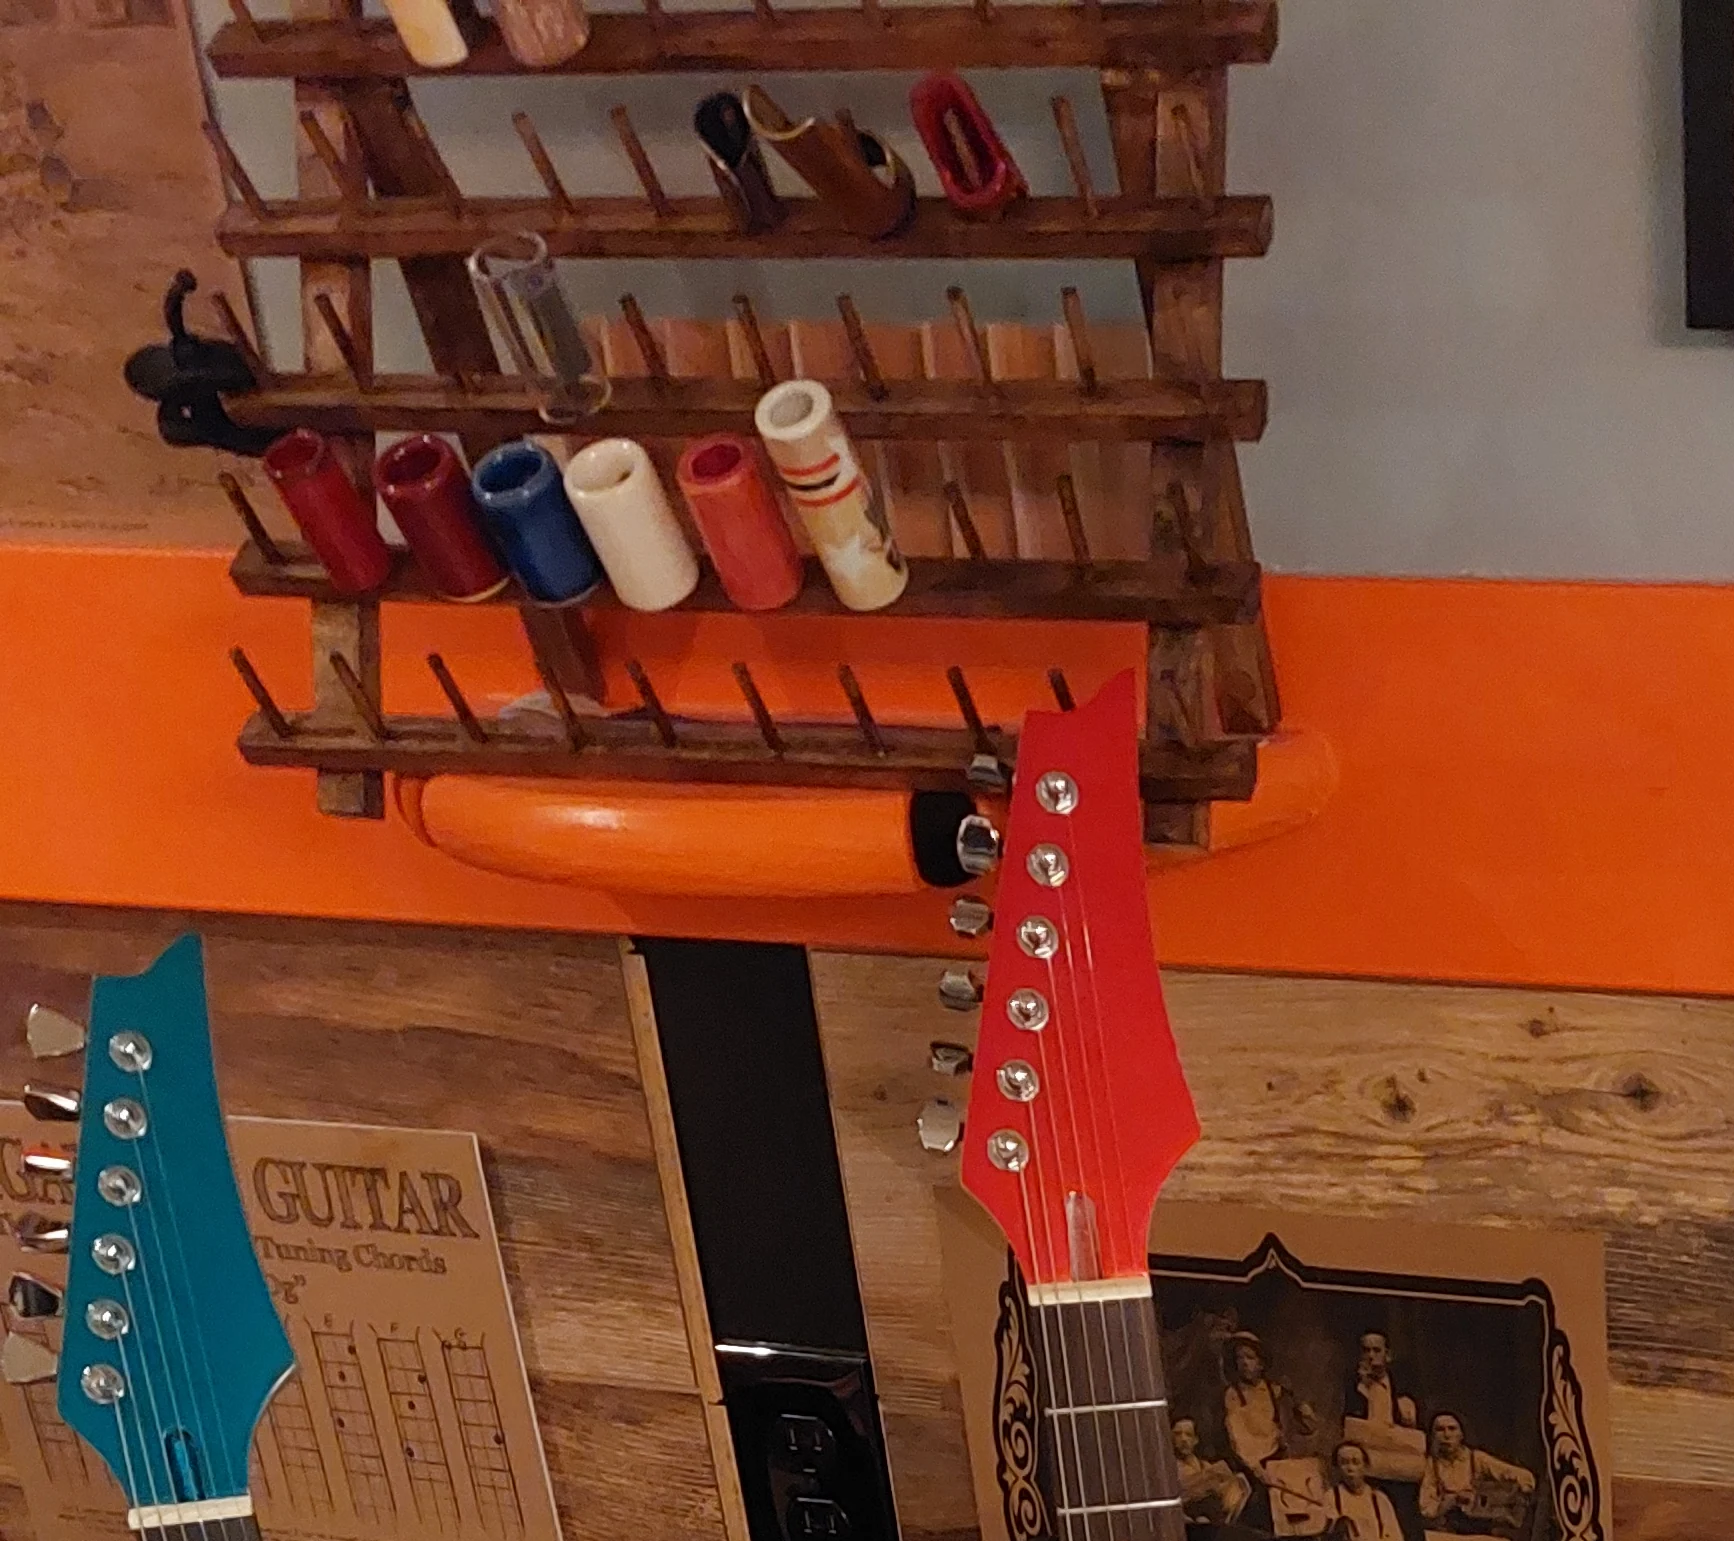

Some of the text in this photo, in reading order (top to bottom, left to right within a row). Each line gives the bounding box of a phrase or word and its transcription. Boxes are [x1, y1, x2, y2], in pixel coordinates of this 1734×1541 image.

[253, 1156, 480, 1239] GUITAR
[253, 1235, 447, 1275] Tuning Chords
